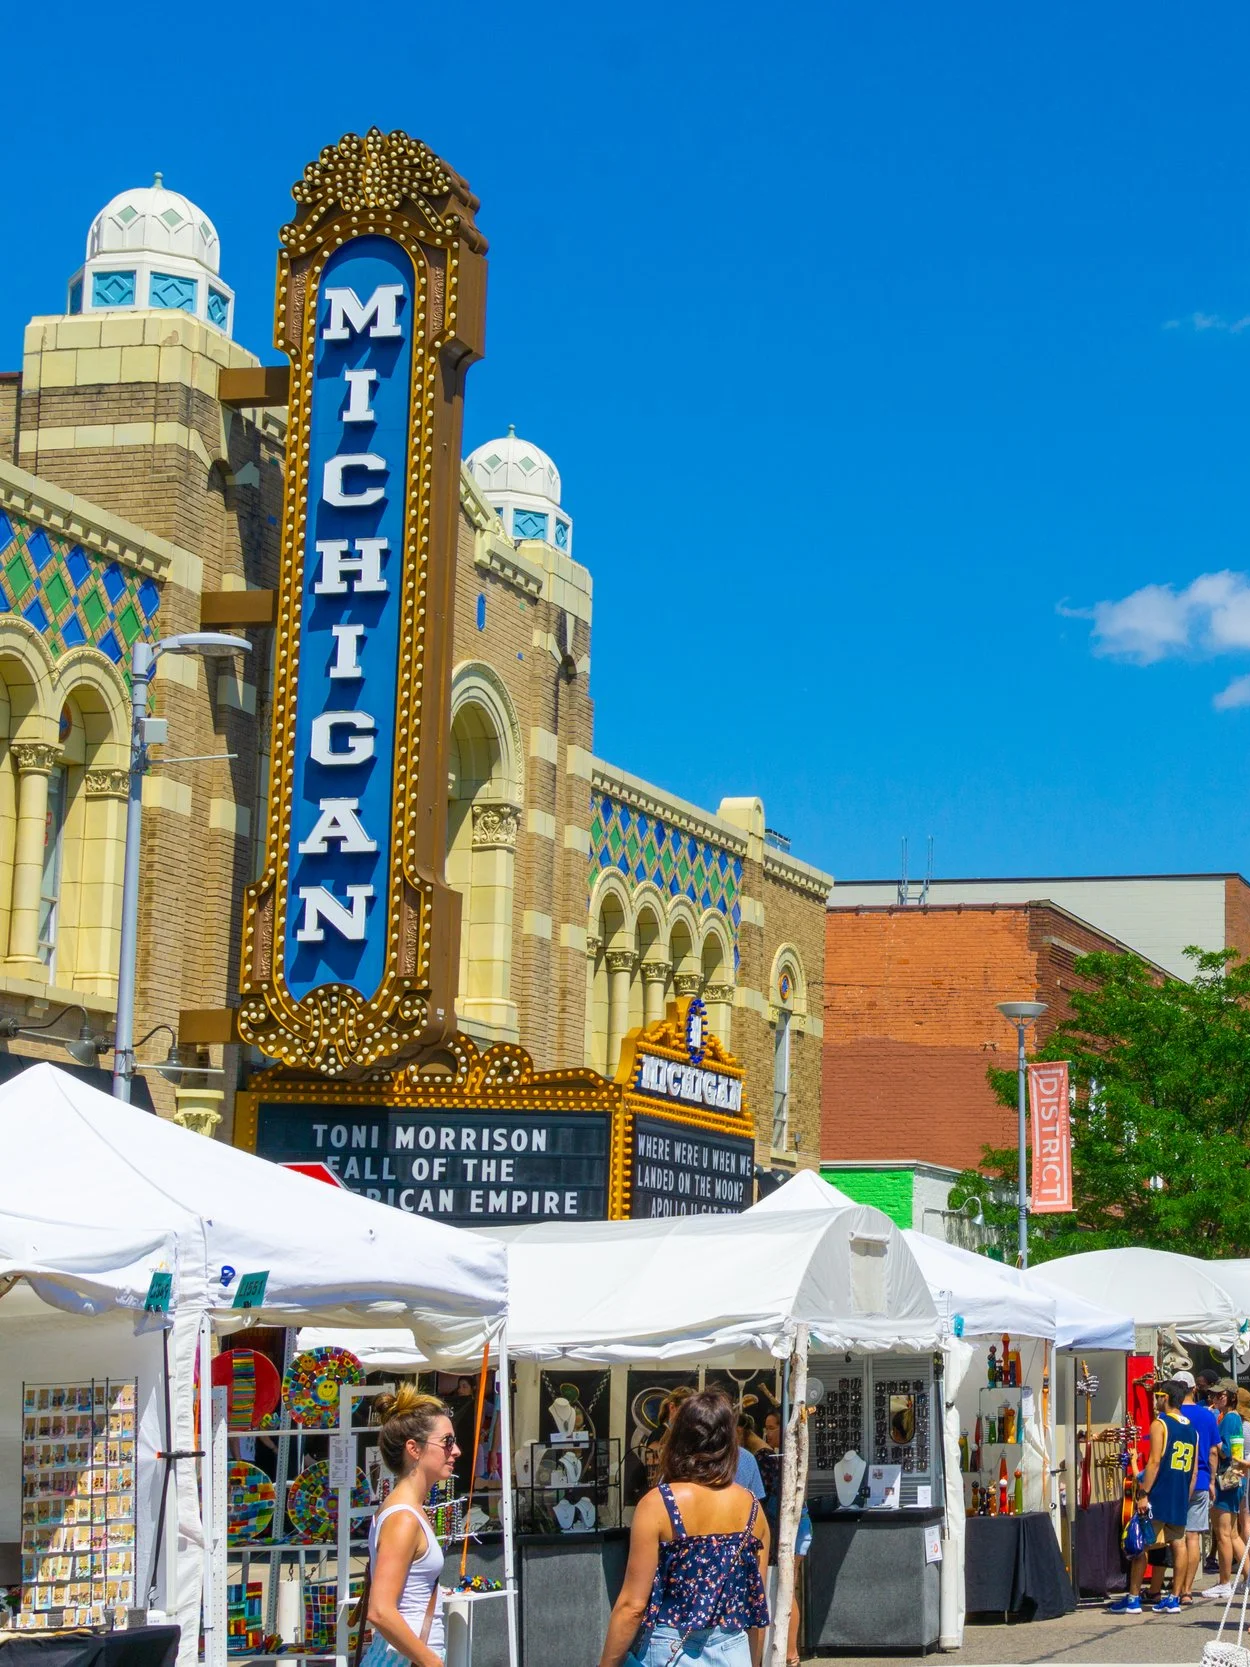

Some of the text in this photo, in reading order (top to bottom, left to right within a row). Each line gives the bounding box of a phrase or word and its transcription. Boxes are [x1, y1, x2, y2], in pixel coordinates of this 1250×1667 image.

[296, 284, 404, 943] MICHIGAN
[641, 1054, 743, 1112] MICHIGAN
[312, 1124, 547, 1152] TONI MORRISON
[638, 1133, 751, 1177] WHERE WERE U WHEN WE
[1039, 1077, 1061, 1199] DISTRICT
[411, 1157, 447, 1182] OF
[463, 1158, 514, 1182] THE
[637, 1164, 744, 1203] LANDED ON THE MOON?
[351, 1188, 578, 1215] RICAN EMPIRE
[651, 1197, 687, 1218] APOLLO
[1170, 1440, 1194, 1473] 23
